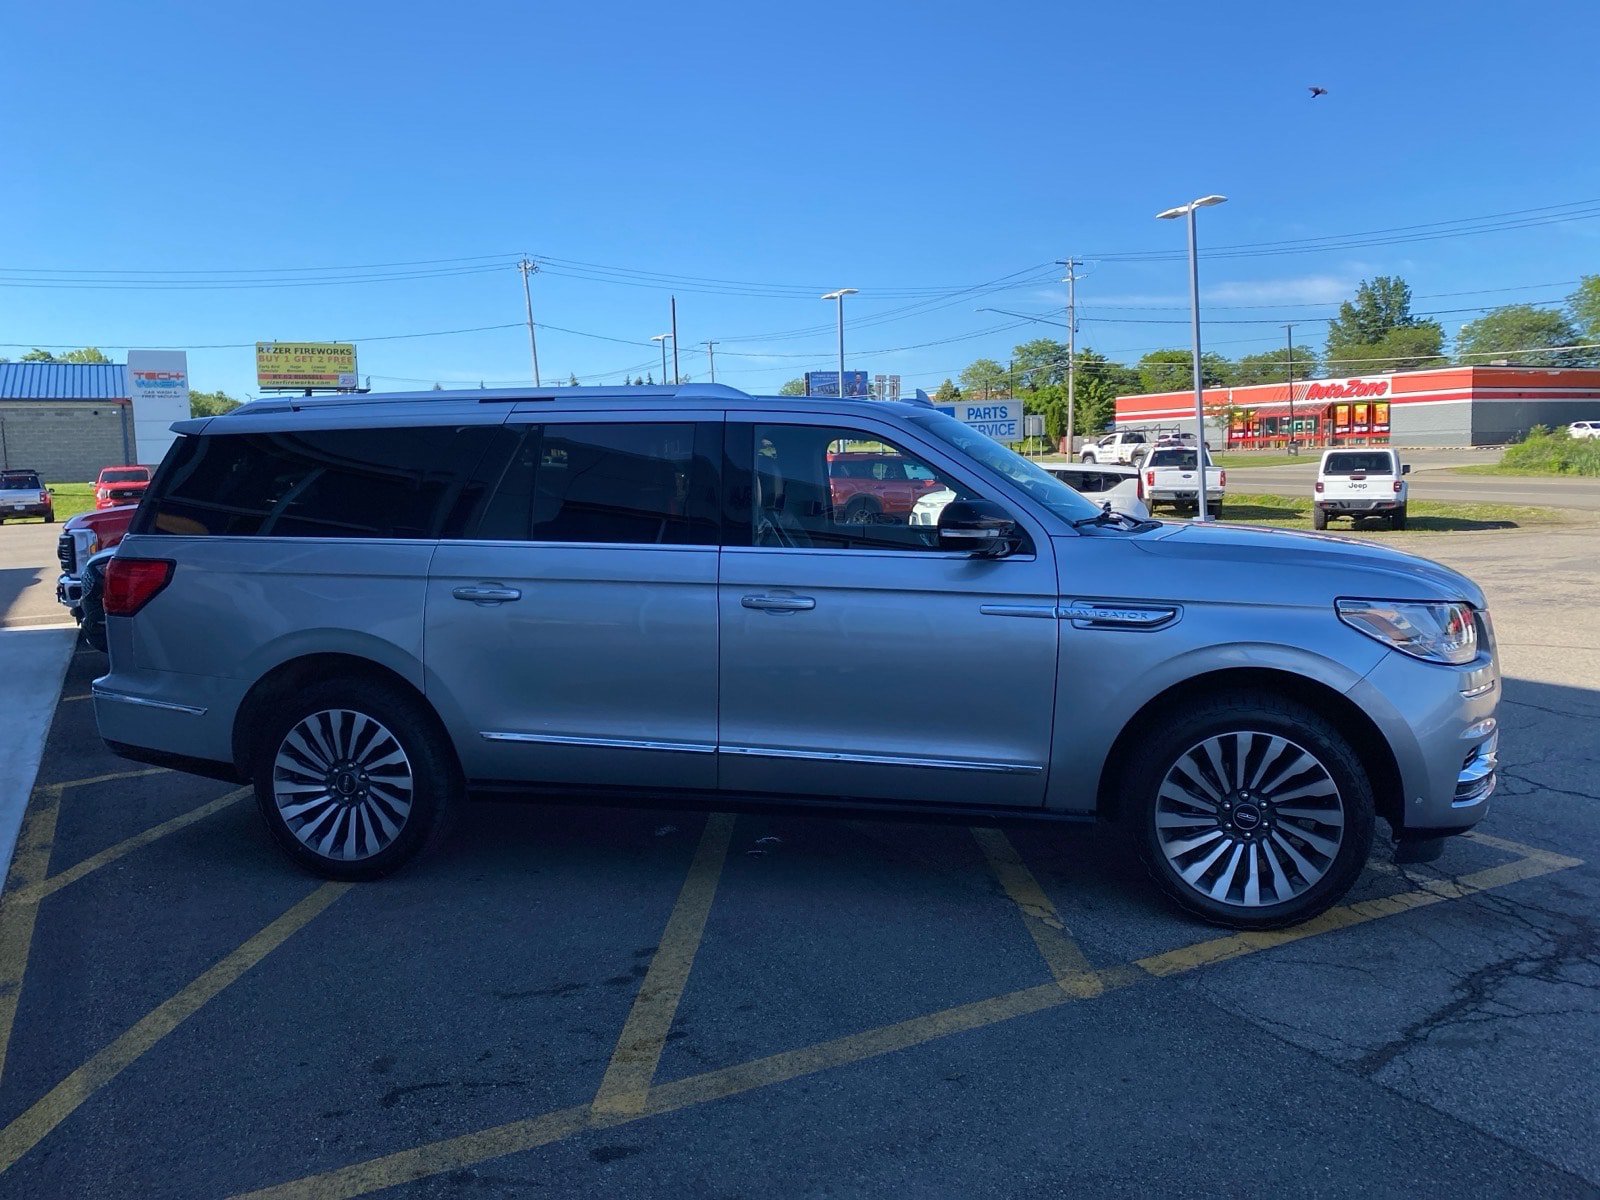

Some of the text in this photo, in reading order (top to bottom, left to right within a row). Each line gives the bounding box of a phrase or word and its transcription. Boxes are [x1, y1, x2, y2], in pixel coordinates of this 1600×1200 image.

[294, 347, 352, 355] FIREWORKS
[294, 355, 313, 363] GET
[327, 356, 352, 364] FREE
[1305, 379, 1389, 400] AutoZone
[967, 405, 1008, 420] PARTS
[970, 423, 1016, 437] RVICE
[1348, 482, 1368, 490] Jeep
[1062, 608, 1149, 619] NAVIGATOR
